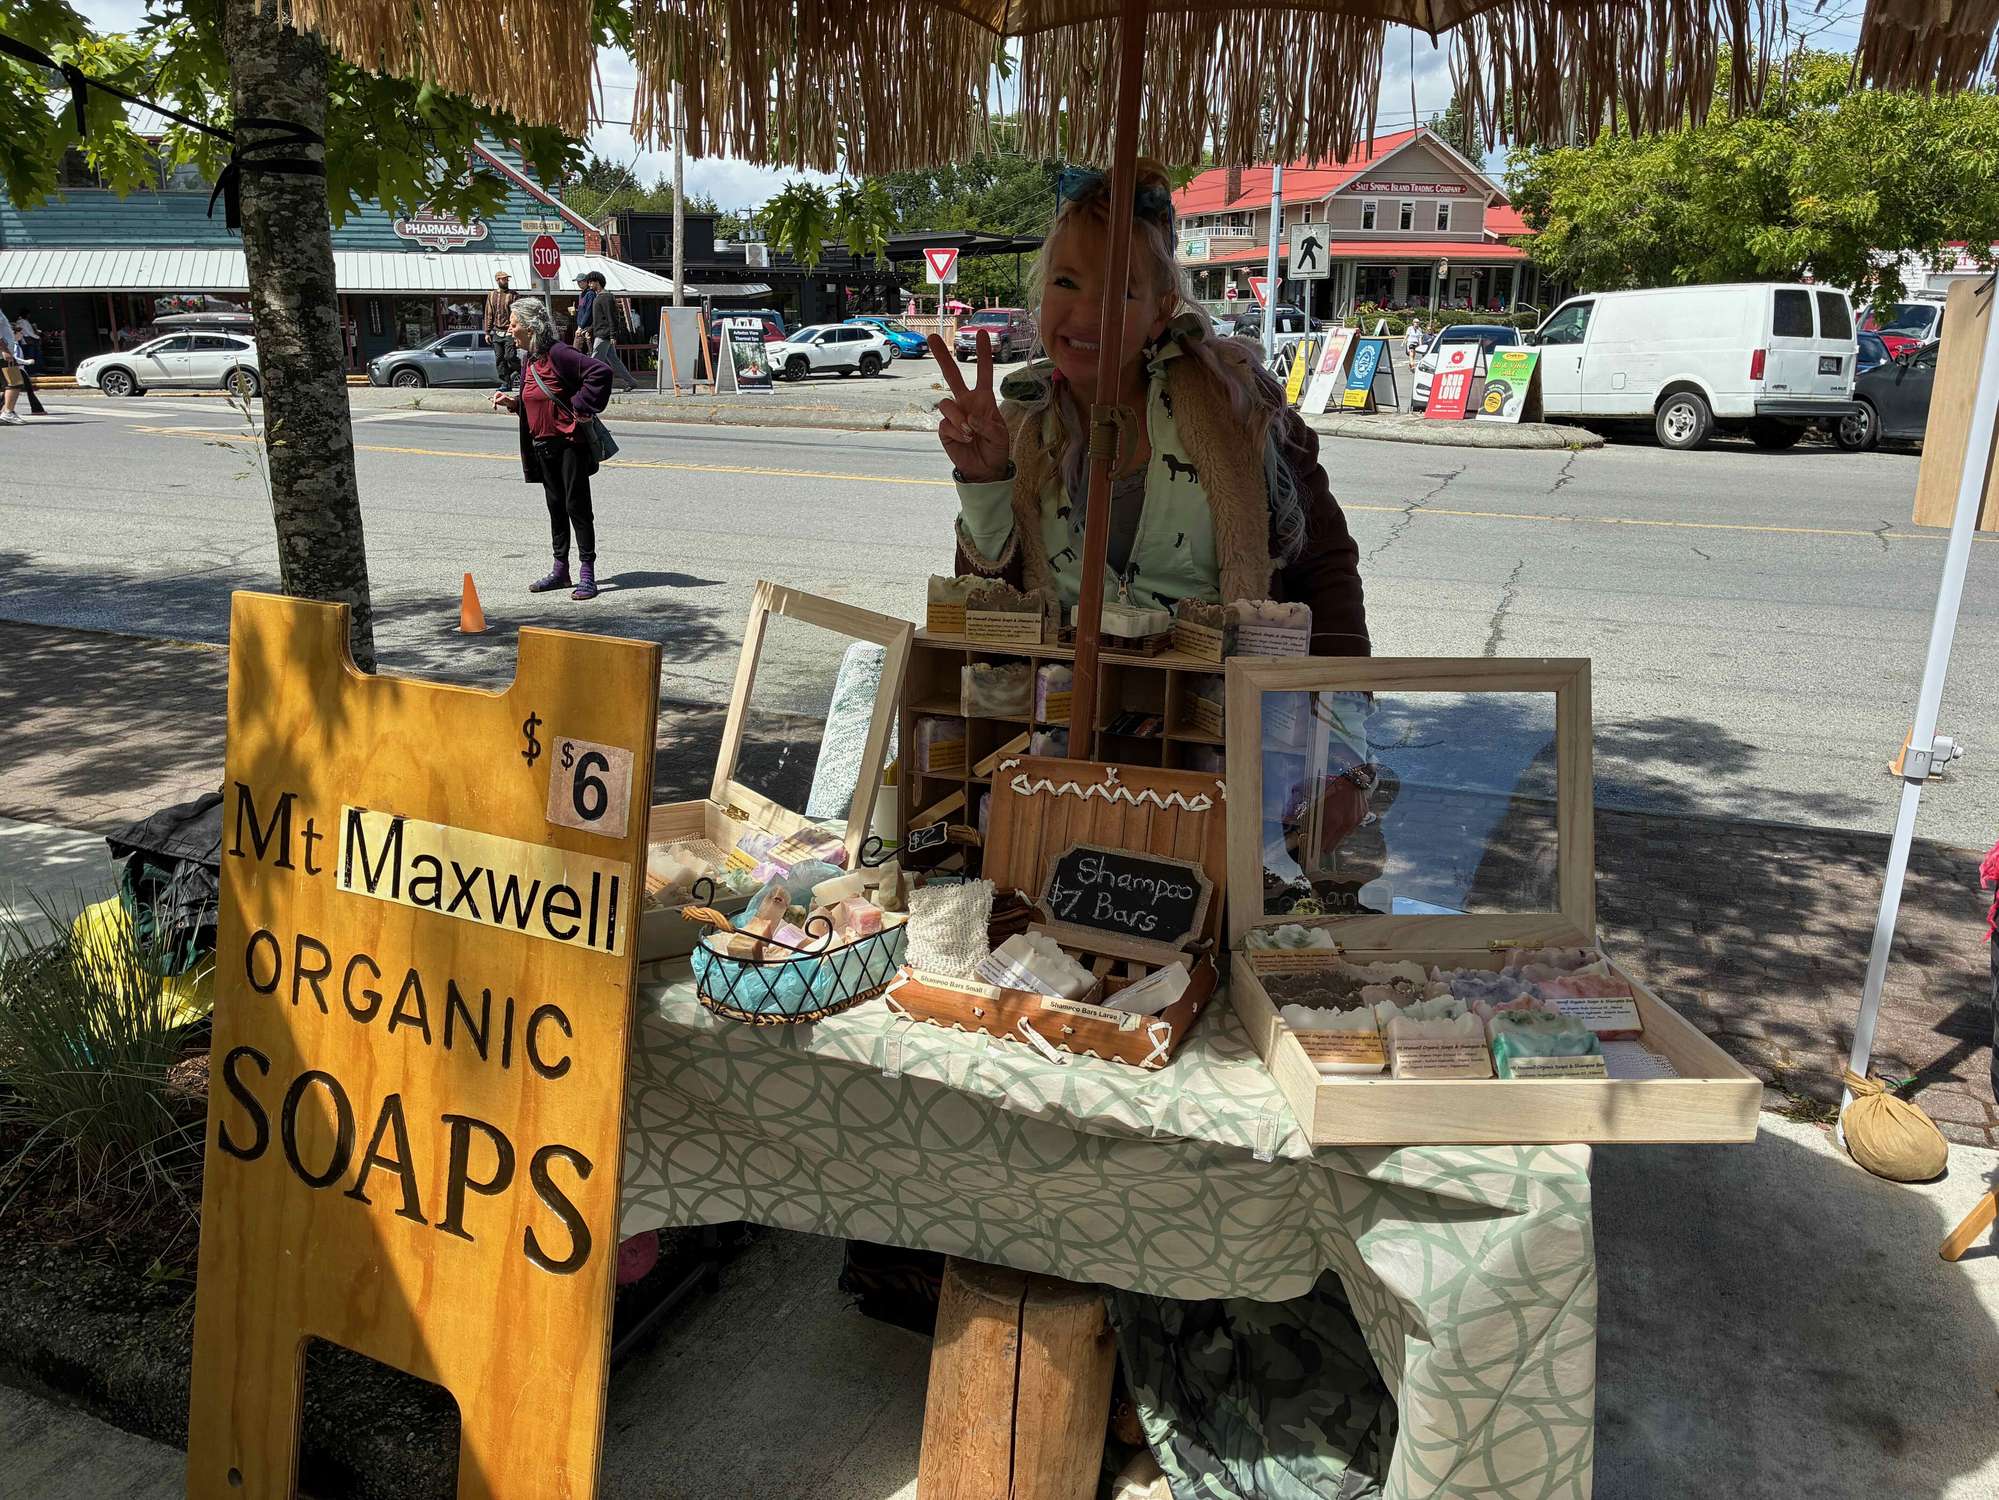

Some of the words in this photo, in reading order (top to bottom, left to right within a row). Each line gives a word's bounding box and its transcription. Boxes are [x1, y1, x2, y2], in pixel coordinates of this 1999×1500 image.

[405, 223, 477, 236] PHARMASAVE
[534, 248, 559, 265] STOP
[522, 711, 542, 768] $
[343, 807, 620, 951] Maxwell
[1076, 856, 1193, 906] Shampoo
[1092, 892, 1158, 931] Bars
[245, 928, 573, 1080] ORGANIC
[920, 975, 949, 986] Shampoo
[949, 981, 964, 990] Bars
[965, 984, 983, 993] Small
[1049, 1001, 1081, 1012] Shampoo
[1081, 1007, 1097, 1016] Bars
[1122, 1011, 1132, 1028] 7
[218, 1045, 594, 1276] SOAPS
